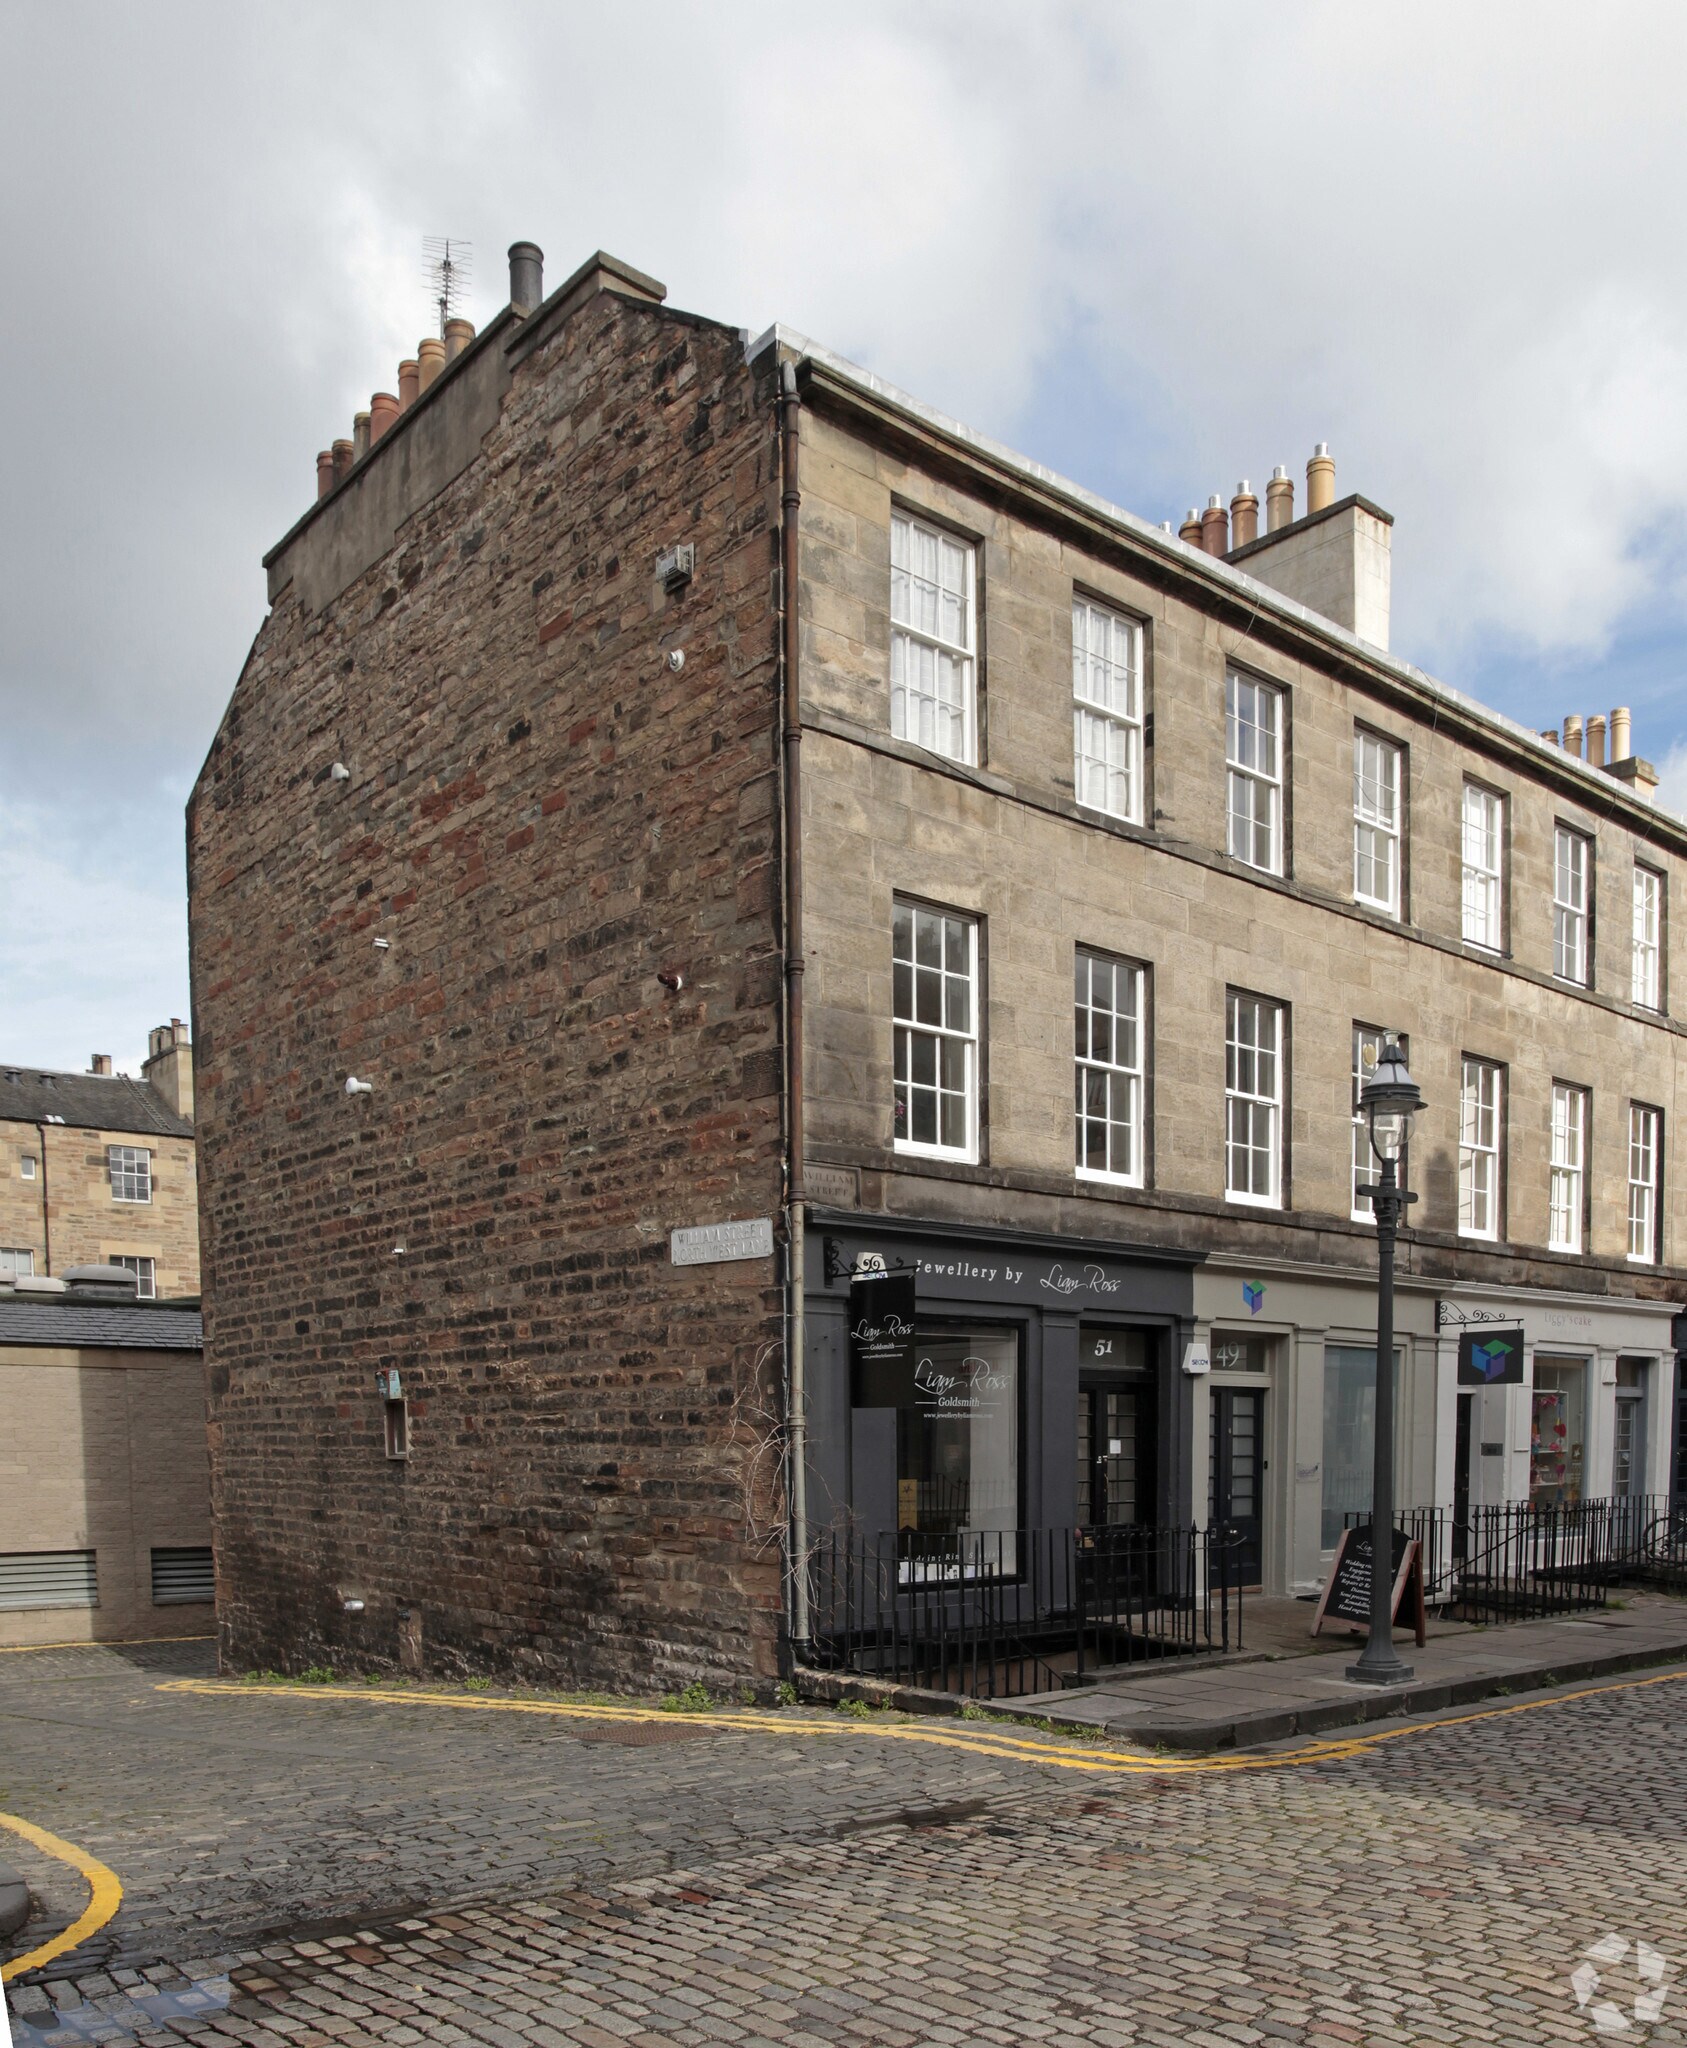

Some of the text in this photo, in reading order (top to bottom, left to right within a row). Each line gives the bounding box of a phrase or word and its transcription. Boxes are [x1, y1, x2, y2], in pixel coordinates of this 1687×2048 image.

[803, 1171, 853, 1185] WILLIAM
[810, 1186, 848, 1197] STREET
[678, 1223, 764, 1246] WILLIAM STREET
[673, 1239, 770, 1262] NORTH WEST LANE
[915, 1259, 1122, 1295] Jewellery by Liam Ross
[851, 1314, 914, 1341] Liam Ross
[870, 1343, 895, 1351] Goldsmith
[1094, 1339, 1113, 1357] 51
[1216, 1341, 1240, 1368] 49
[914, 1357, 1011, 1395] Liam Ross
[938, 1396, 980, 1408] Goldsmith
